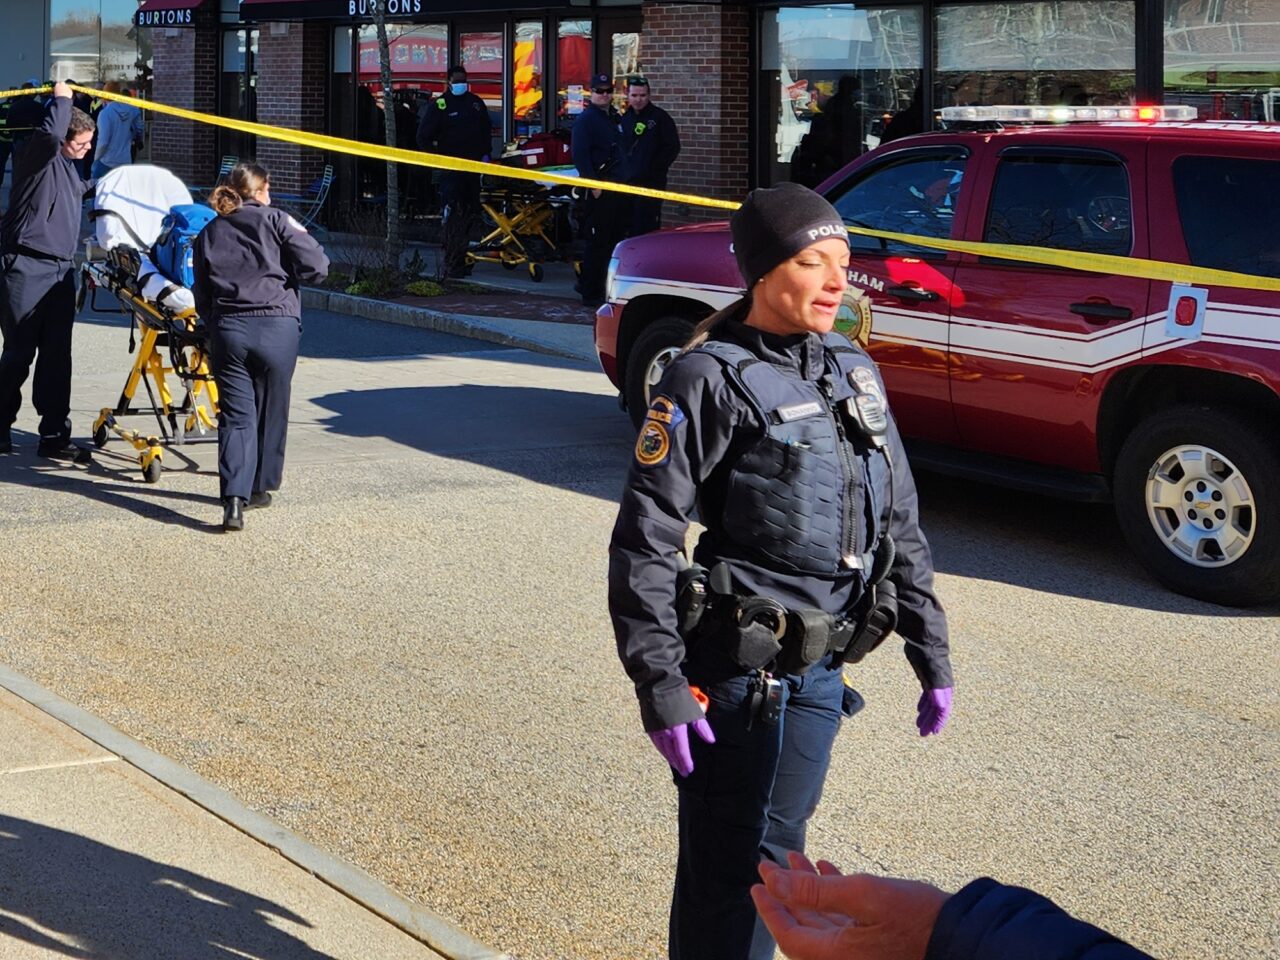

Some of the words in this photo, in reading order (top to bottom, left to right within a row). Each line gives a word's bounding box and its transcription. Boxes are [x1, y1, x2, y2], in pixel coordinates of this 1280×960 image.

[139, 8, 192, 25] BURTONS
[807, 224, 848, 241] POLIC
[847, 270, 885, 292] HAM
